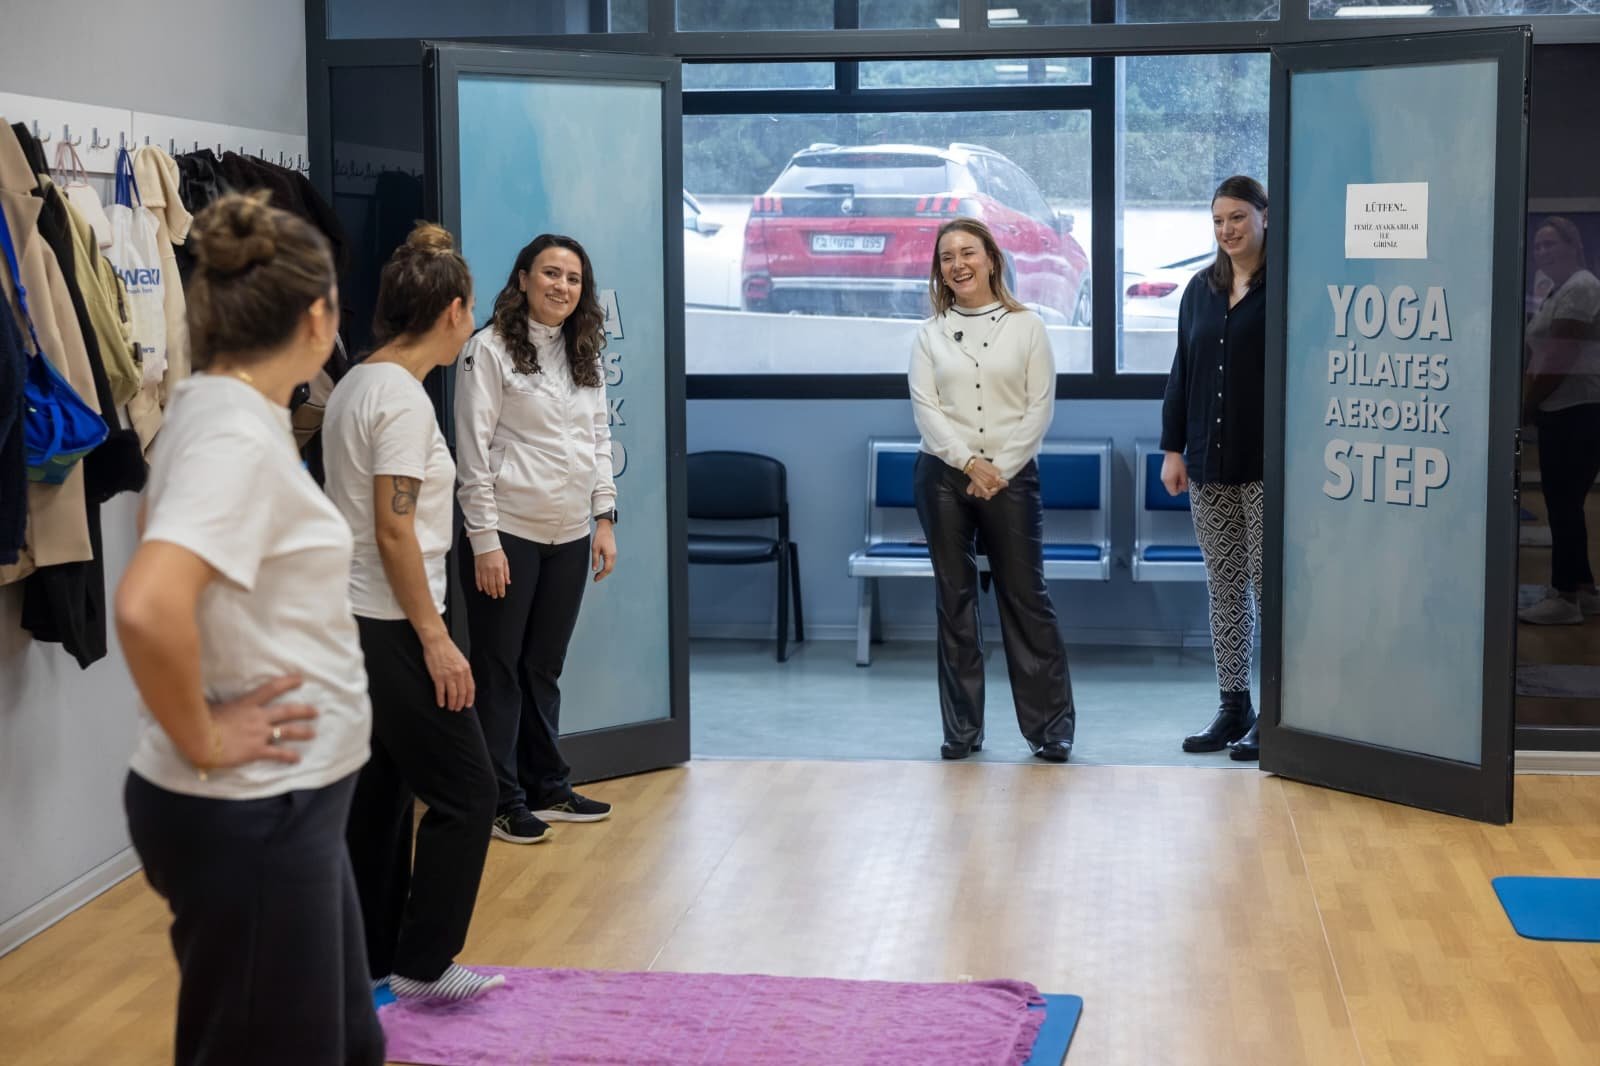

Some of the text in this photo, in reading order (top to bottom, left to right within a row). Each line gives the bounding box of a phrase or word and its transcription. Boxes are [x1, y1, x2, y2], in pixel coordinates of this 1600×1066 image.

[1327, 284, 1452, 341] YOGA
[1328, 341, 1449, 390] PİLATES
[1325, 392, 1450, 434] AEROBİK
[1322, 439, 1450, 507] STEP
